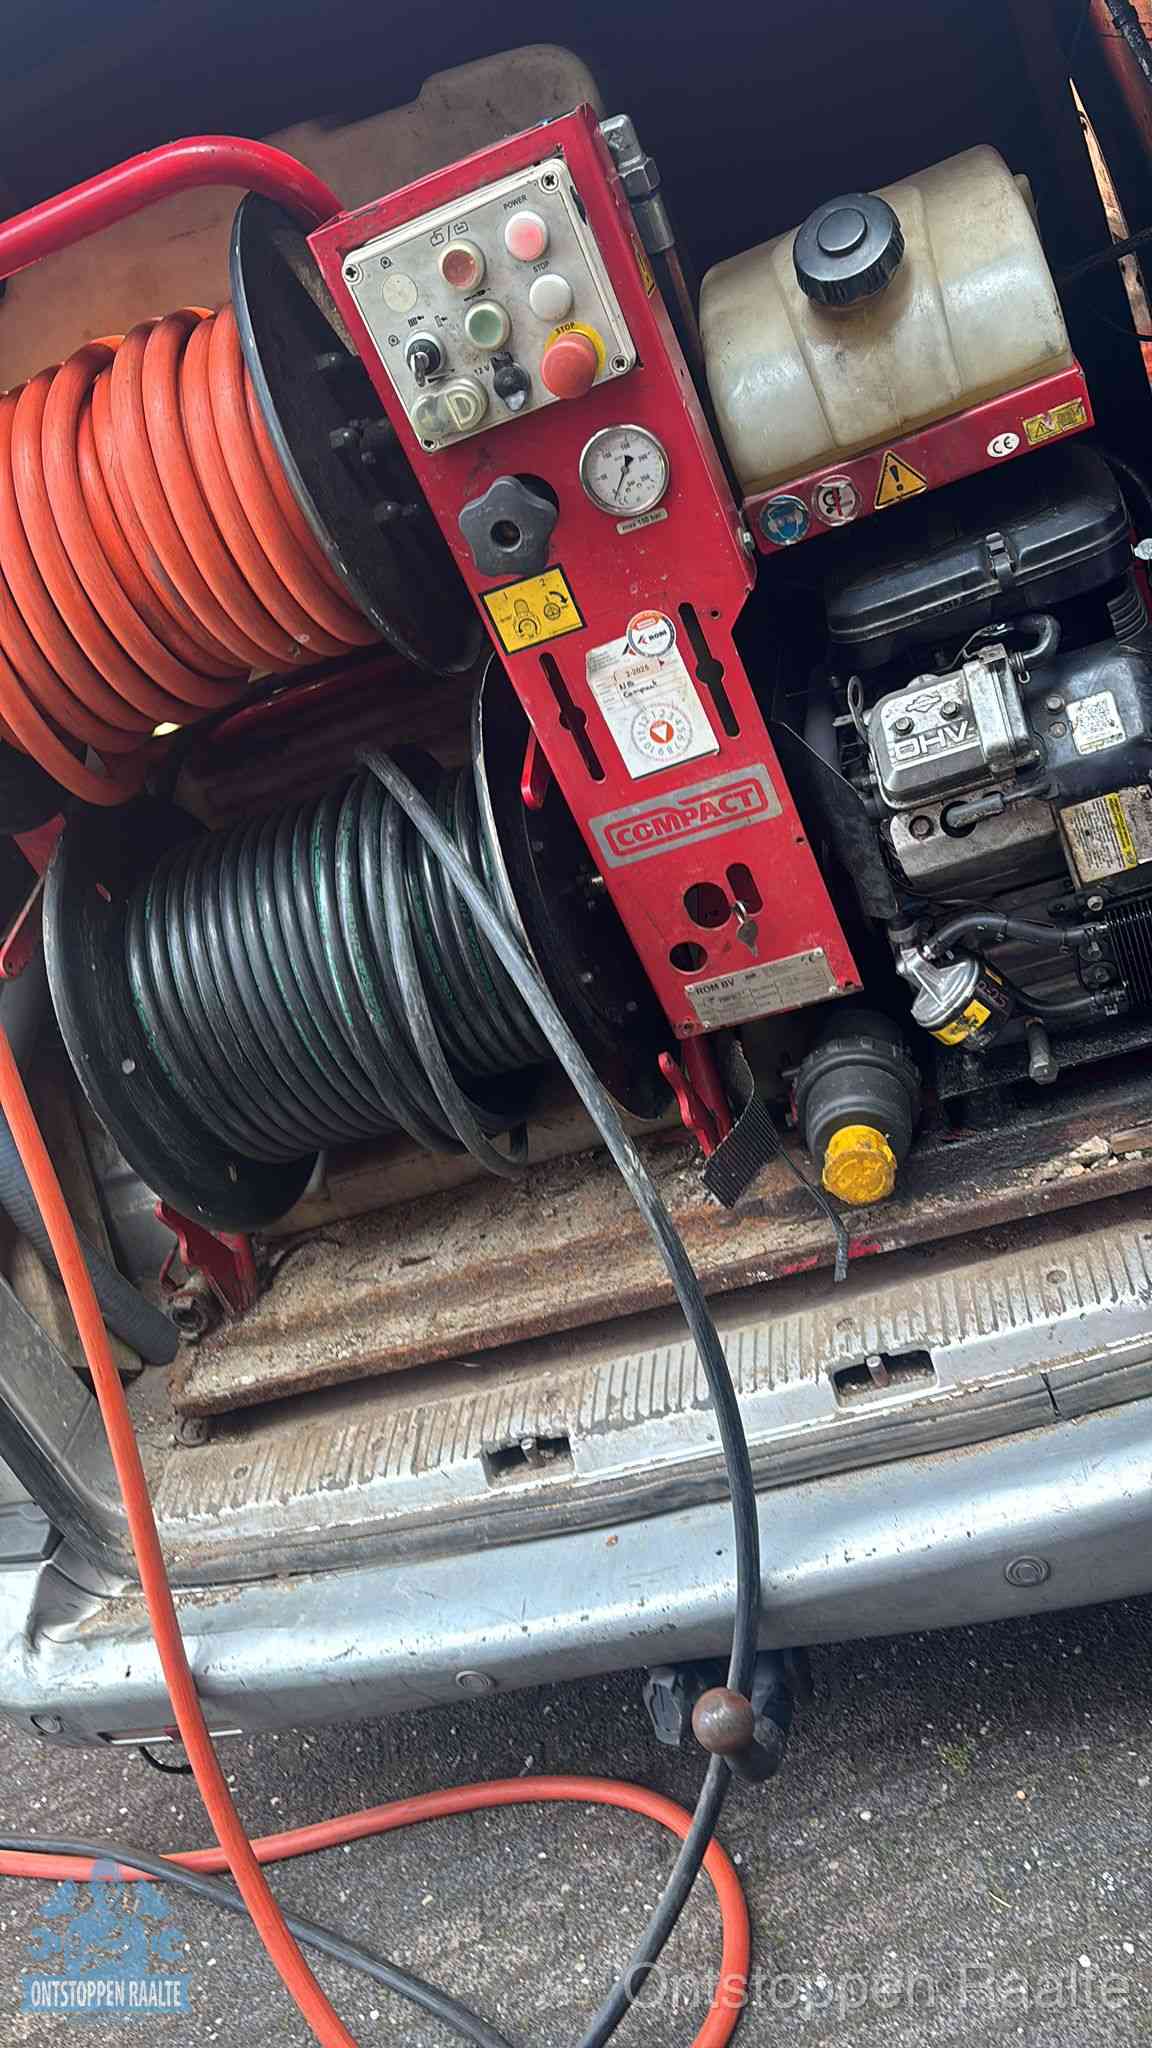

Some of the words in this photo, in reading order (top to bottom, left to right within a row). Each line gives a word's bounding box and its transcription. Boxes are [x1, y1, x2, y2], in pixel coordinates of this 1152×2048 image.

[503, 194, 528, 211] POWER
[532, 260, 550, 274] STOP
[555, 322, 576, 335] STOP
[992, 435, 1014, 454] CE
[894, 720, 969, 761] OHV
[616, 787, 756, 847] COMPACT
